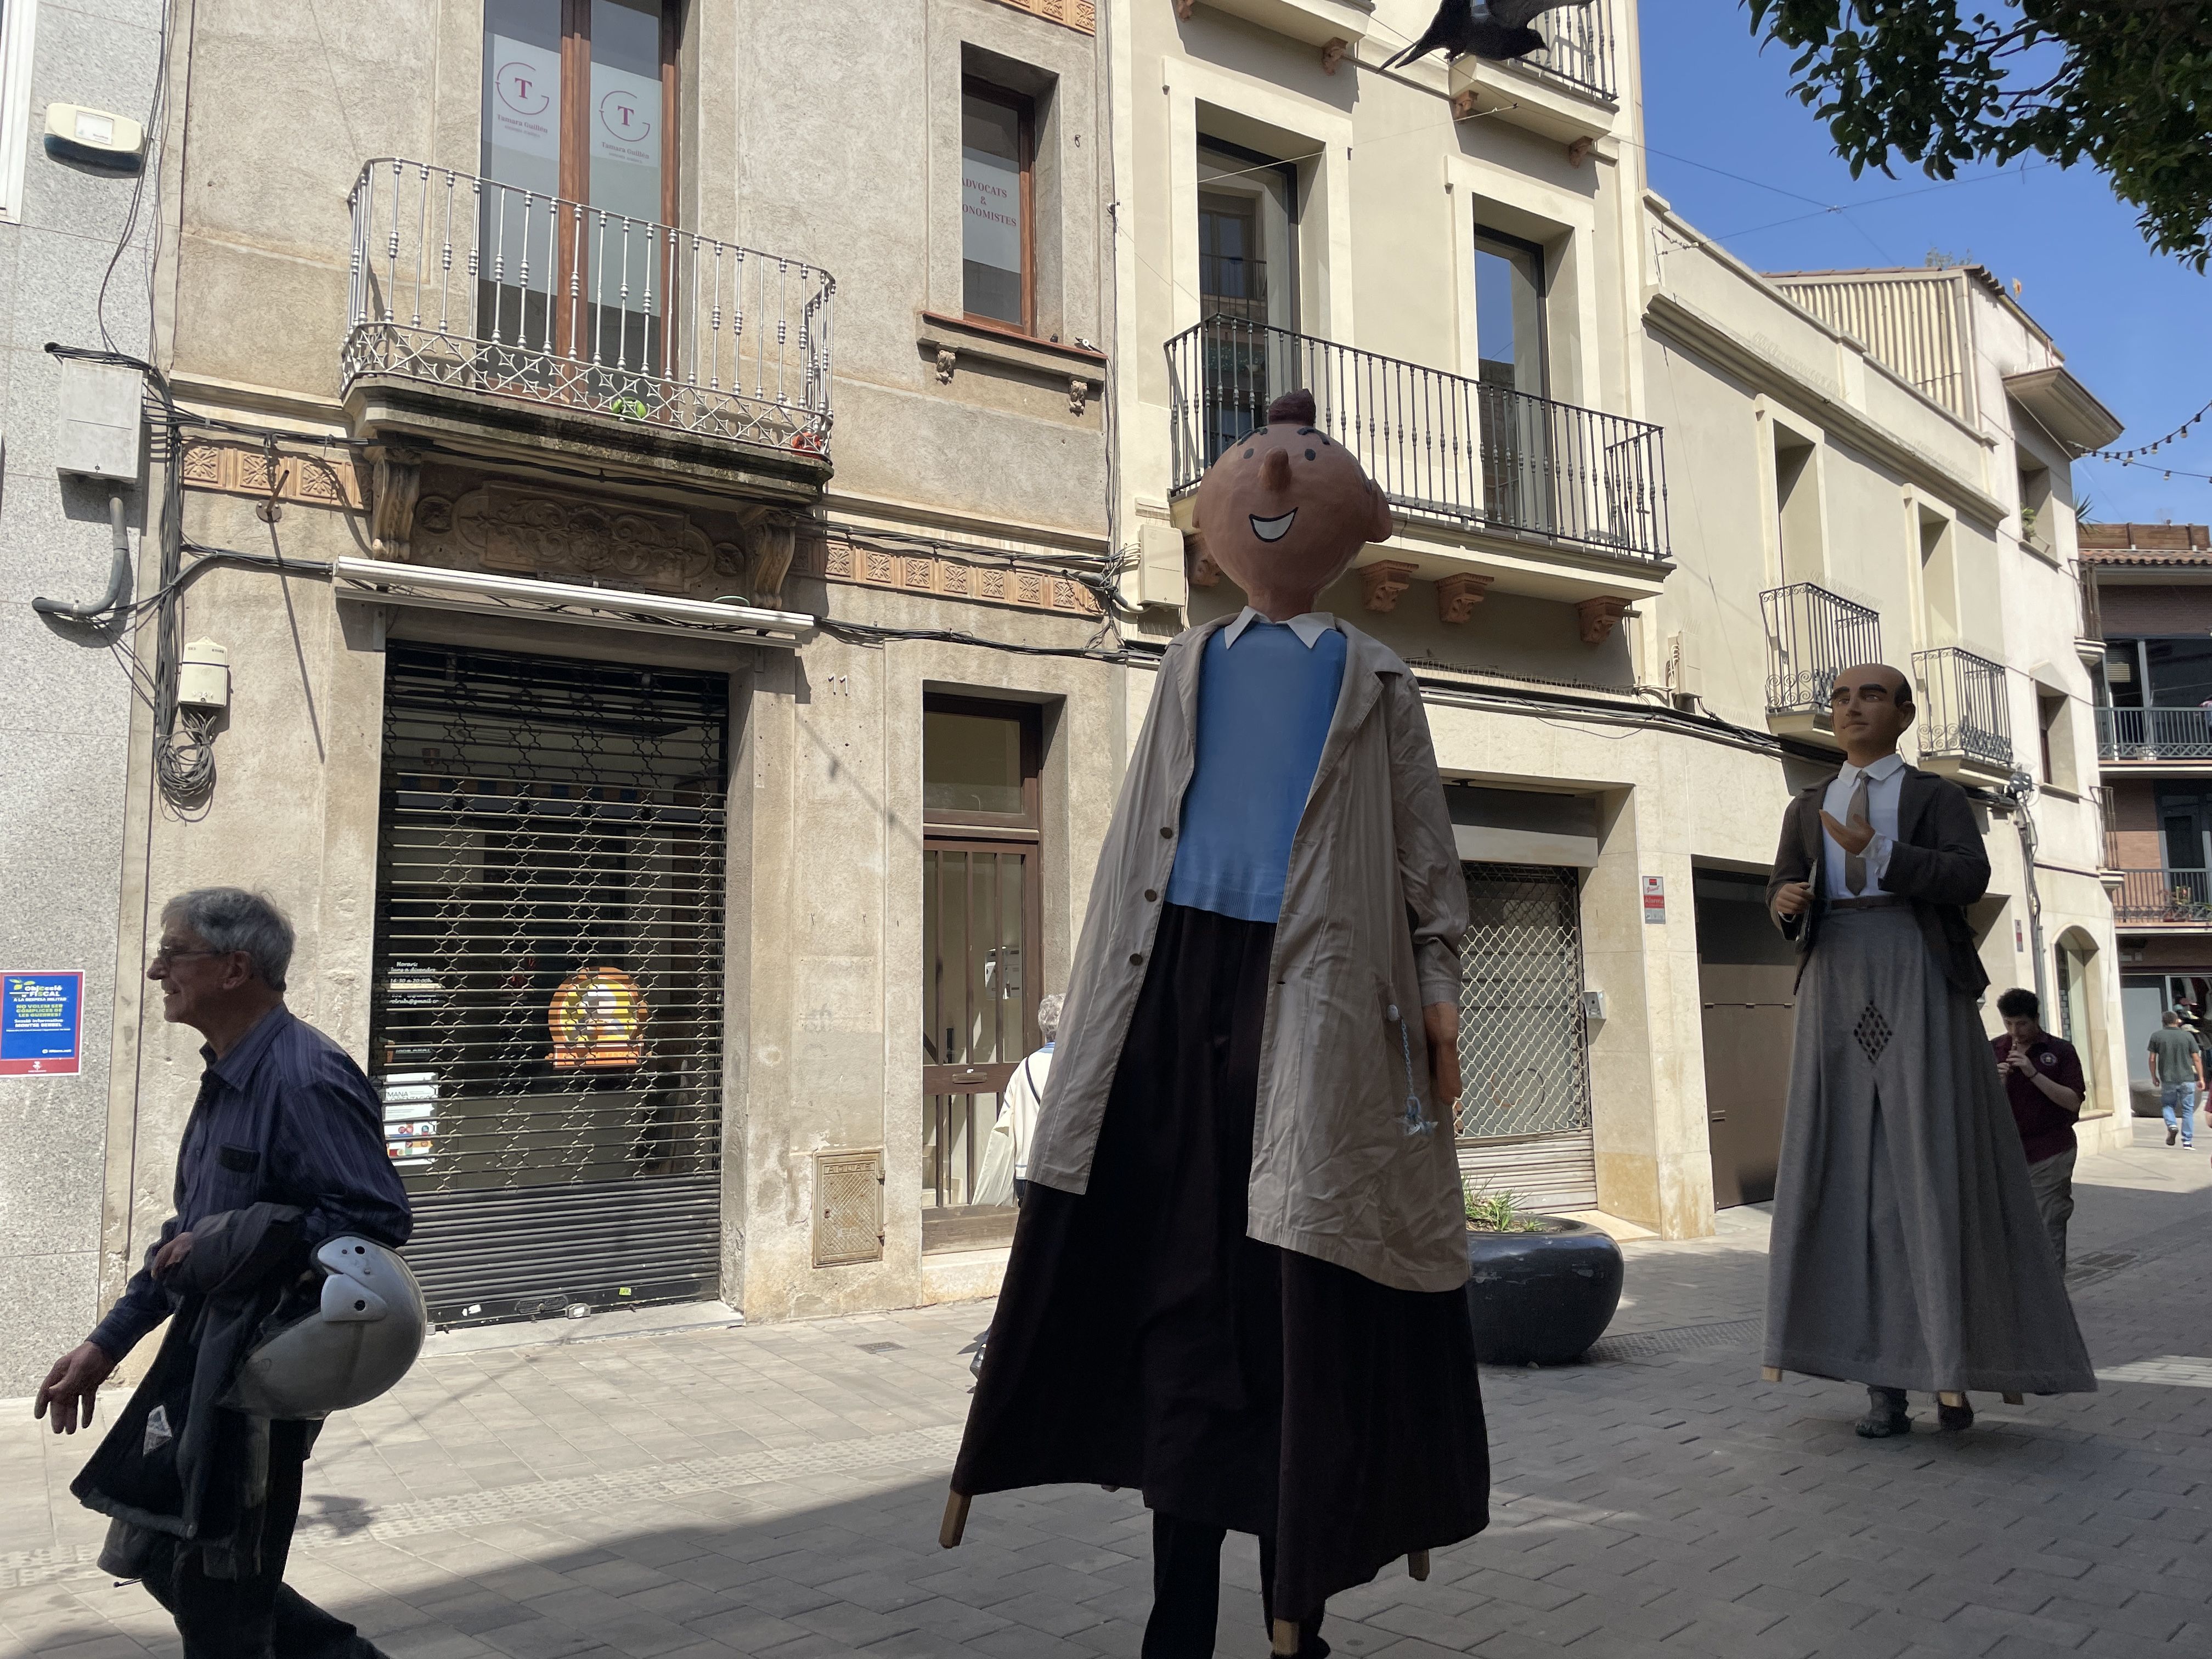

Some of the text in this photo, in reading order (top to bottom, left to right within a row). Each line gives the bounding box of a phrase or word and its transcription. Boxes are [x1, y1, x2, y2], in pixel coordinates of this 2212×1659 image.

[515, 77, 532, 99] T
[497, 114, 523, 126] Tamara
[618, 105, 634, 127] T
[601, 142, 626, 153] Tamara
[980, 196, 986, 206] &
[827, 673, 848, 696] 11
[828, 1163, 871, 1174] AGUAS
